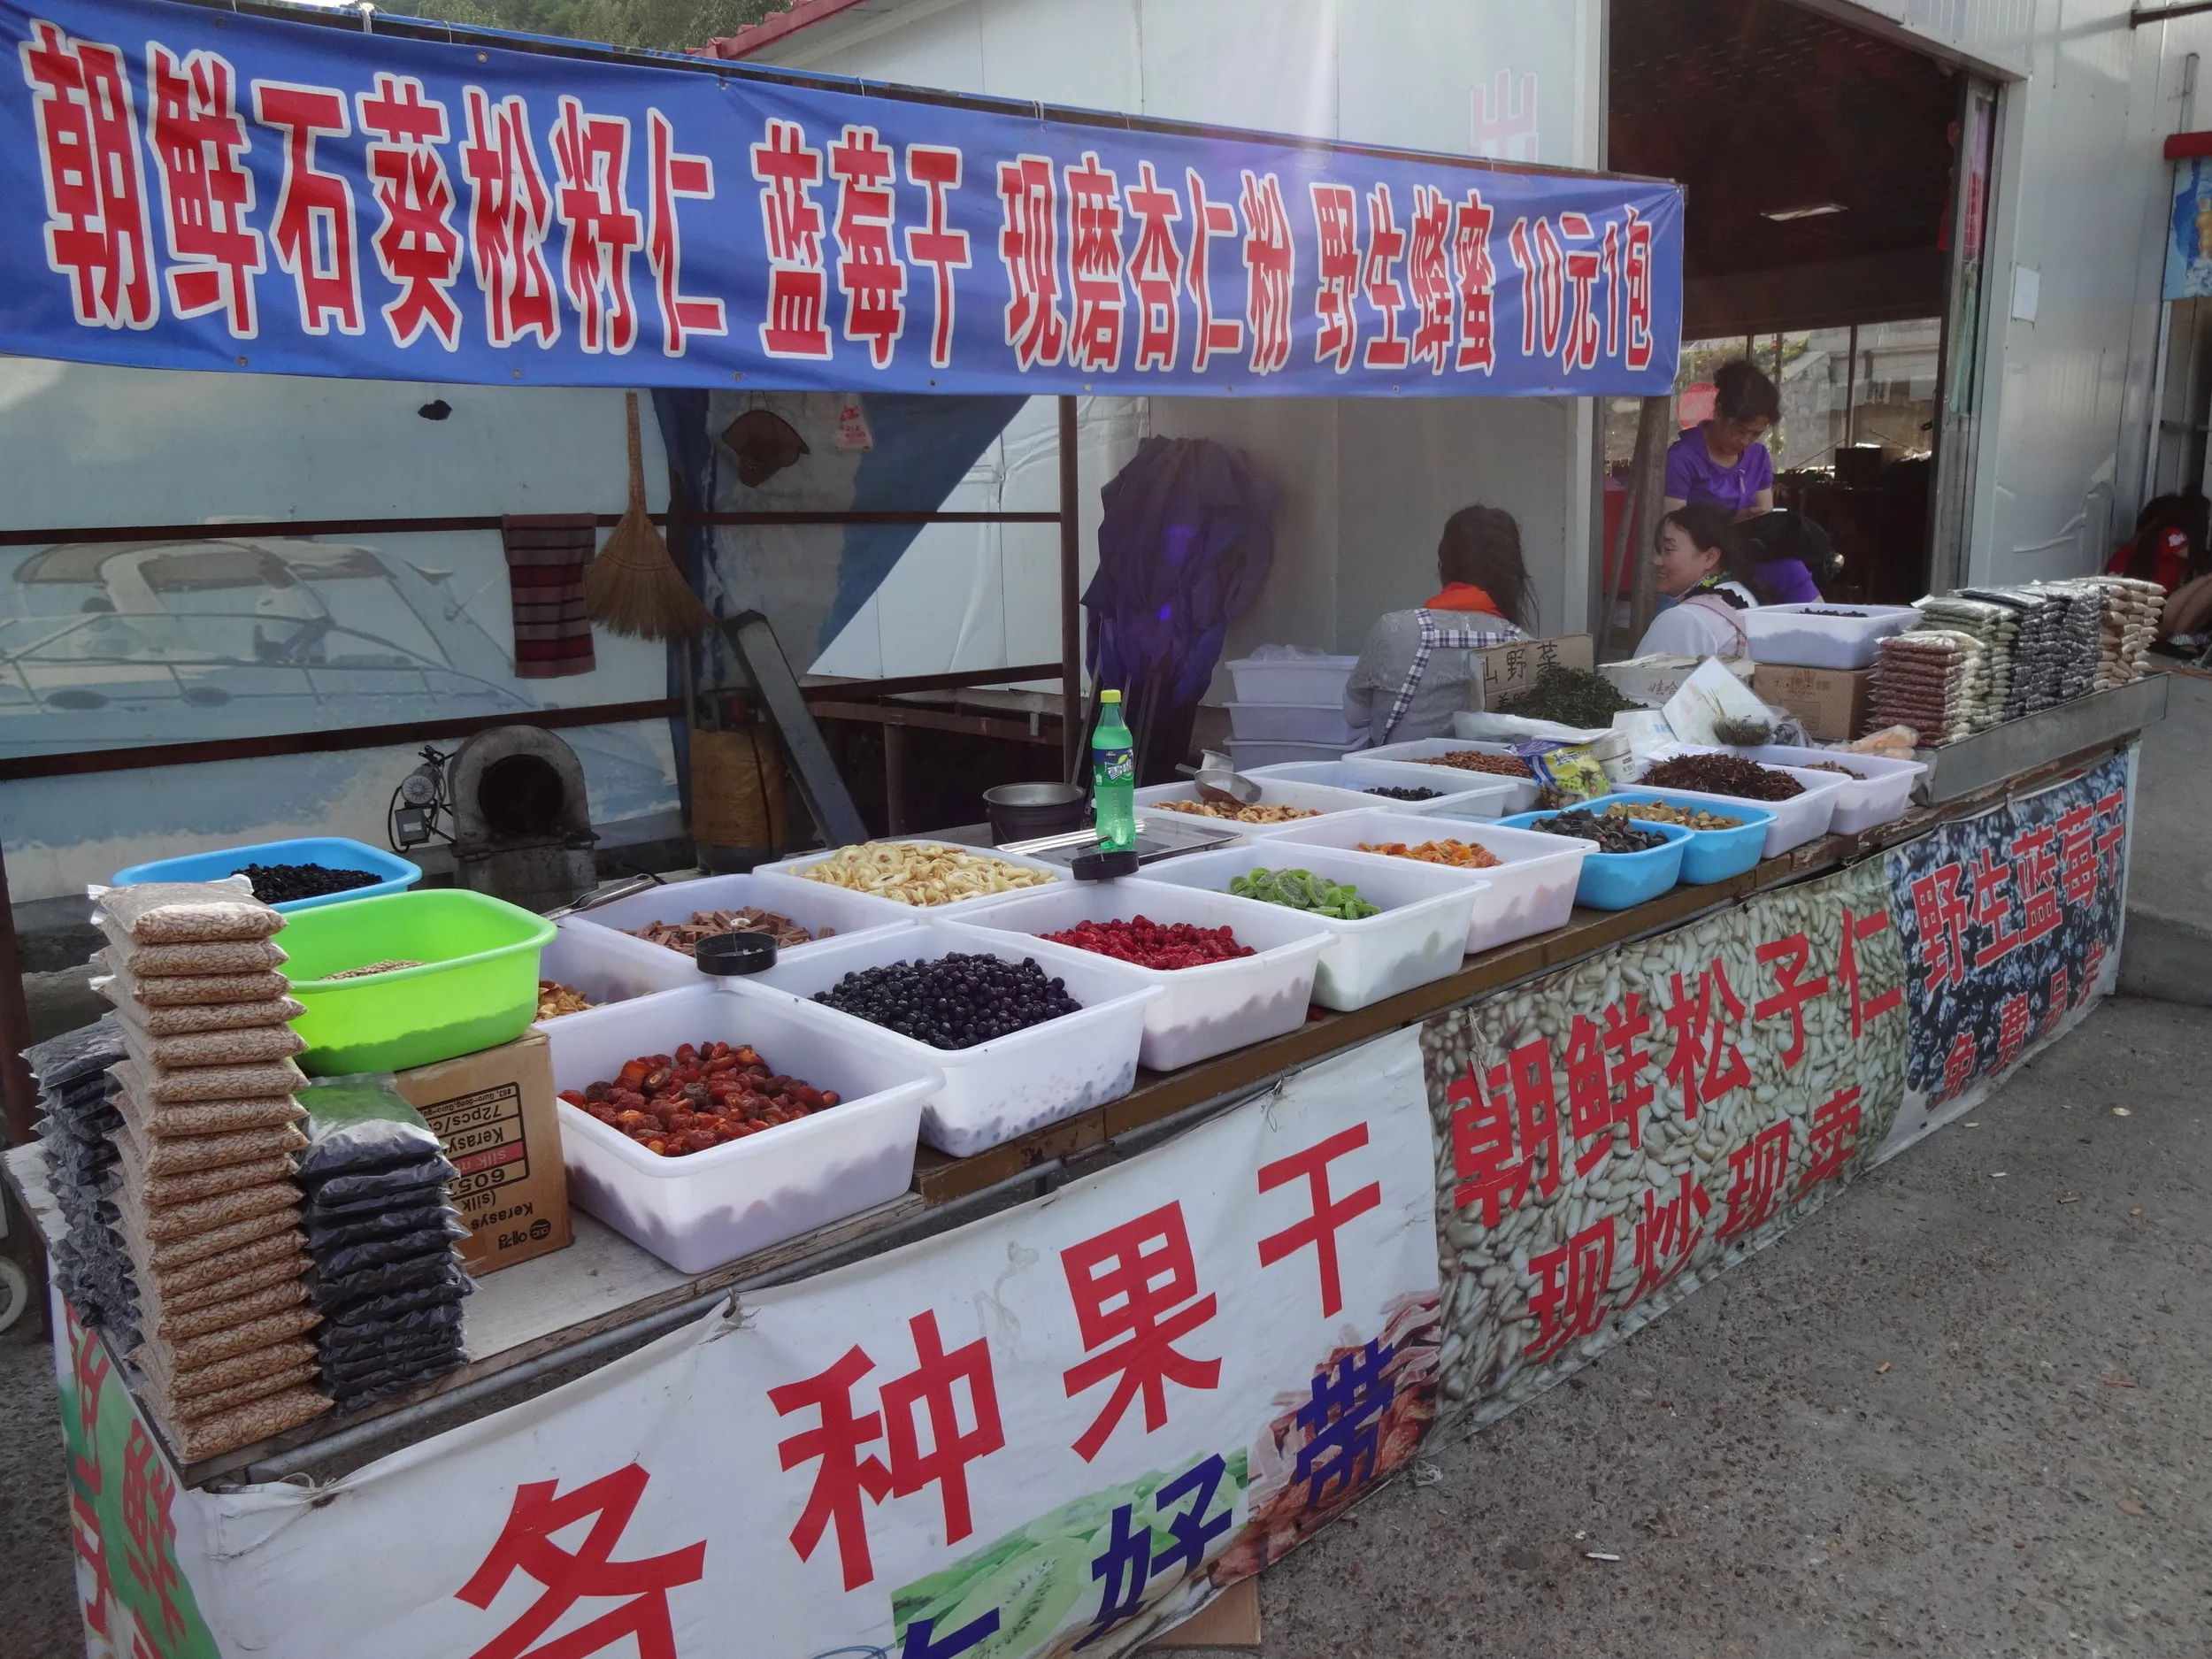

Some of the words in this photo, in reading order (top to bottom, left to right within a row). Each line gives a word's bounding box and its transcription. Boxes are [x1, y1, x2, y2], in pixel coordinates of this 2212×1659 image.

[750, 118, 972, 370] 蓝莓干
[996, 150, 1295, 376] 现磨杏仁粉
[1309, 181, 1496, 377] 野生蜂蜜
[1508, 204, 1654, 375] 10元1包
[1911, 788, 2124, 995] 野生蓝莓干
[479, 1149, 506, 1169] silk
[1446, 907, 1902, 1228] 朝鲜松子仁
[462, 1190, 496, 1211] (silk
[471, 1202, 534, 1231] Kerasys
[1524, 1086, 1862, 1363] 现炒现卖
[455, 1121, 1381, 1659] 各种果干
